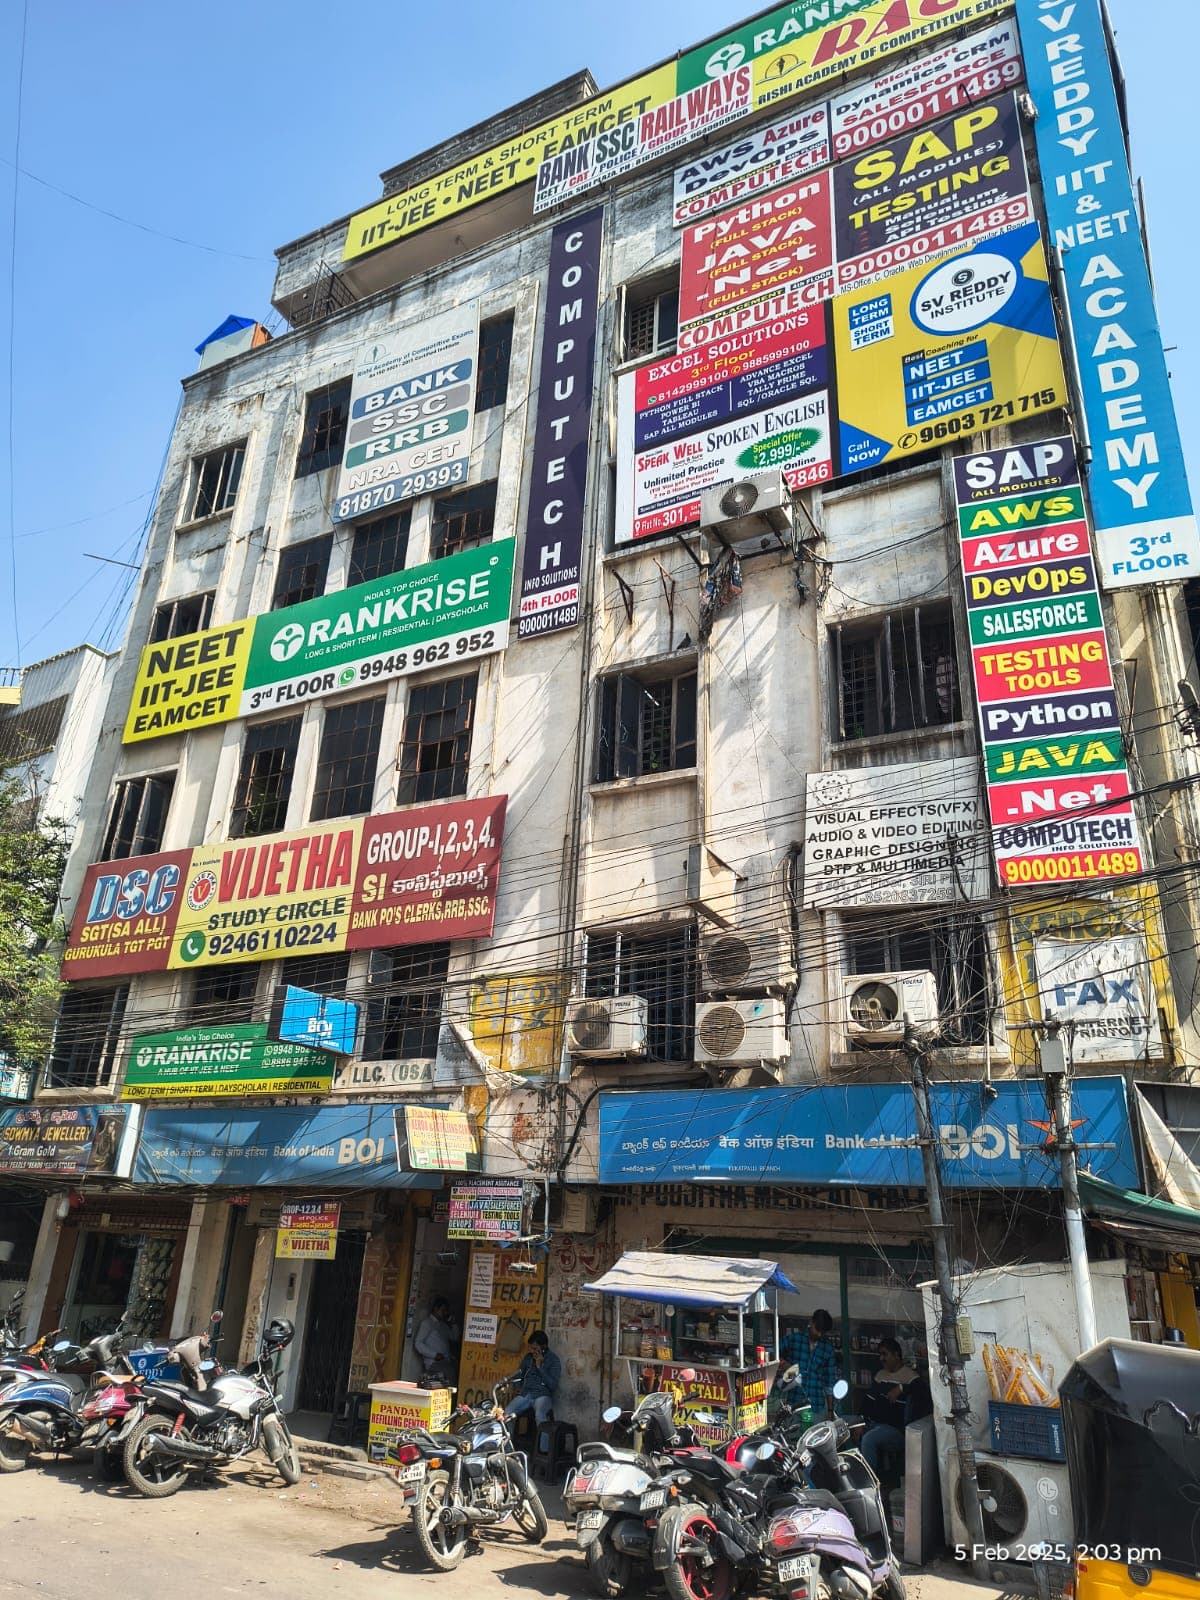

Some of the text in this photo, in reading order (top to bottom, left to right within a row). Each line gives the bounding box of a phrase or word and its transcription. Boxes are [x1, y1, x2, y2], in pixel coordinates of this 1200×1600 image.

[836, 32, 1009, 116] Dynamics CRM
[843, 48, 1006, 126] SALESFORCE
[538, 65, 750, 191] BANK SSC RAILWAYS
[680, 141, 754, 184] AWS
[763, 110, 825, 146] Azure
[853, 106, 998, 190] SAP
[676, 144, 827, 219] COMPUTECH
[849, 156, 1010, 229] TESTING
[1055, 160, 1113, 196] IIT
[693, 182, 820, 243] Python
[1075, 194, 1102, 215] &
[696, 217, 817, 274] JAVA
[1055, 209, 1130, 252] NEET
[679, 277, 834, 349] COMPUTECH
[852, 299, 888, 317] LONG
[852, 307, 890, 325] TERM
[931, 287, 1006, 320] INSTITUTE
[854, 320, 889, 337] SHORT
[854, 327, 891, 345] TERM
[648, 352, 703, 383] EXCEL
[708, 313, 809, 359] SOLUTIONS
[691, 348, 756, 379] 3rd Floor
[910, 350, 964, 380] NEET
[364, 364, 460, 413] BANK
[914, 387, 988, 421] EAMCET
[371, 394, 448, 434] SSC
[662, 409, 699, 427] TABLEAU
[920, 388, 1056, 444] 9603 721 715
[365, 418, 450, 460] RRB
[753, 432, 802, 453] Special Offer
[848, 440, 870, 453] Call
[349, 440, 460, 490] NRA CET
[784, 457, 816, 470] Online
[848, 447, 881, 465] NOW
[966, 444, 1064, 489] SAP
[644, 469, 685, 489] Unlimited
[688, 458, 725, 475] Practice
[971, 476, 1062, 499] (ALL MODULES)
[970, 496, 1075, 531] AWS
[973, 533, 1080, 567] Azure
[1112, 553, 1189, 576] FLOOR
[364, 574, 439, 603] INDIA'S TOP CHOICE
[525, 566, 578, 592] INFO SOLUTIONS
[971, 566, 1087, 600] DevOps
[307, 570, 491, 646] RANKRISE
[521, 588, 578, 613] 4th FLOOR
[305, 602, 489, 660] LONG & SHORT TERM RESIDENTIAL DAYSCHOLAR
[519, 606, 577, 636] 9000011489
[982, 601, 1088, 637] SALESFORCE
[146, 627, 245, 678] NEET
[979, 641, 1104, 675] TESTING
[250, 630, 494, 709] 3rd FLOOR 9948 962 952
[1005, 668, 1081, 692] TOOLS
[139, 663, 236, 708] IIT-JEE
[133, 694, 231, 734] EAMCET
[987, 701, 1112, 733] Python
[995, 741, 1116, 774] JAVA
[814, 801, 977, 825] VISUAL EFFECTS(VFX)
[808, 818, 985, 844] AUDIO & VIDEO EDITING
[1000, 818, 1132, 849] COMPUTECH
[1051, 840, 1133, 852] INFO SOLUTIONS
[218, 830, 354, 903] VIJETHA
[1006, 852, 1138, 883] 9000011489
[87, 864, 180, 924] DSC
[361, 873, 387, 903] SI
[208, 897, 346, 931] STUDY CIRCLE
[64, 935, 170, 961] GURUKULA TGT PGT
[209, 922, 337, 957] 9246110224
[1055, 979, 1139, 1007] FAX
[307, 1017, 333, 1038] BOI
[153, 1041, 253, 1066] RANKRISE
[128, 1086, 146, 1096] LONG
[170, 1086, 193, 1094] SHORT
[272, 1081, 322, 1091] RESIDENTIAL
[4, 1126, 92, 1141] SOWMYA JEWELLERY
[719, 1134, 814, 1150] बैंक इंडिया
[825, 1134, 865, 1149] Bank
[939, 1124, 1018, 1160] BOI
[14, 1145, 56, 1156] Gram Gold
[274, 1145, 334, 1157] Bank of India
[338, 1137, 383, 1164] BOI
[469, 1201, 488, 1210] JAVA
[490, 1201, 520, 1210] SALESFORCE
[482, 1211, 520, 1220] TESTING TOOLS
[280, 1216, 292, 1228] SI
[449, 1220, 519, 1229] DEVOPS PYTHON AWS
[292, 1240, 330, 1250] VIJETHA
[351, 1364, 369, 1377] STD
[371, 1413, 402, 1427] REFILLING
[380, 1404, 422, 1418] PANDAY
